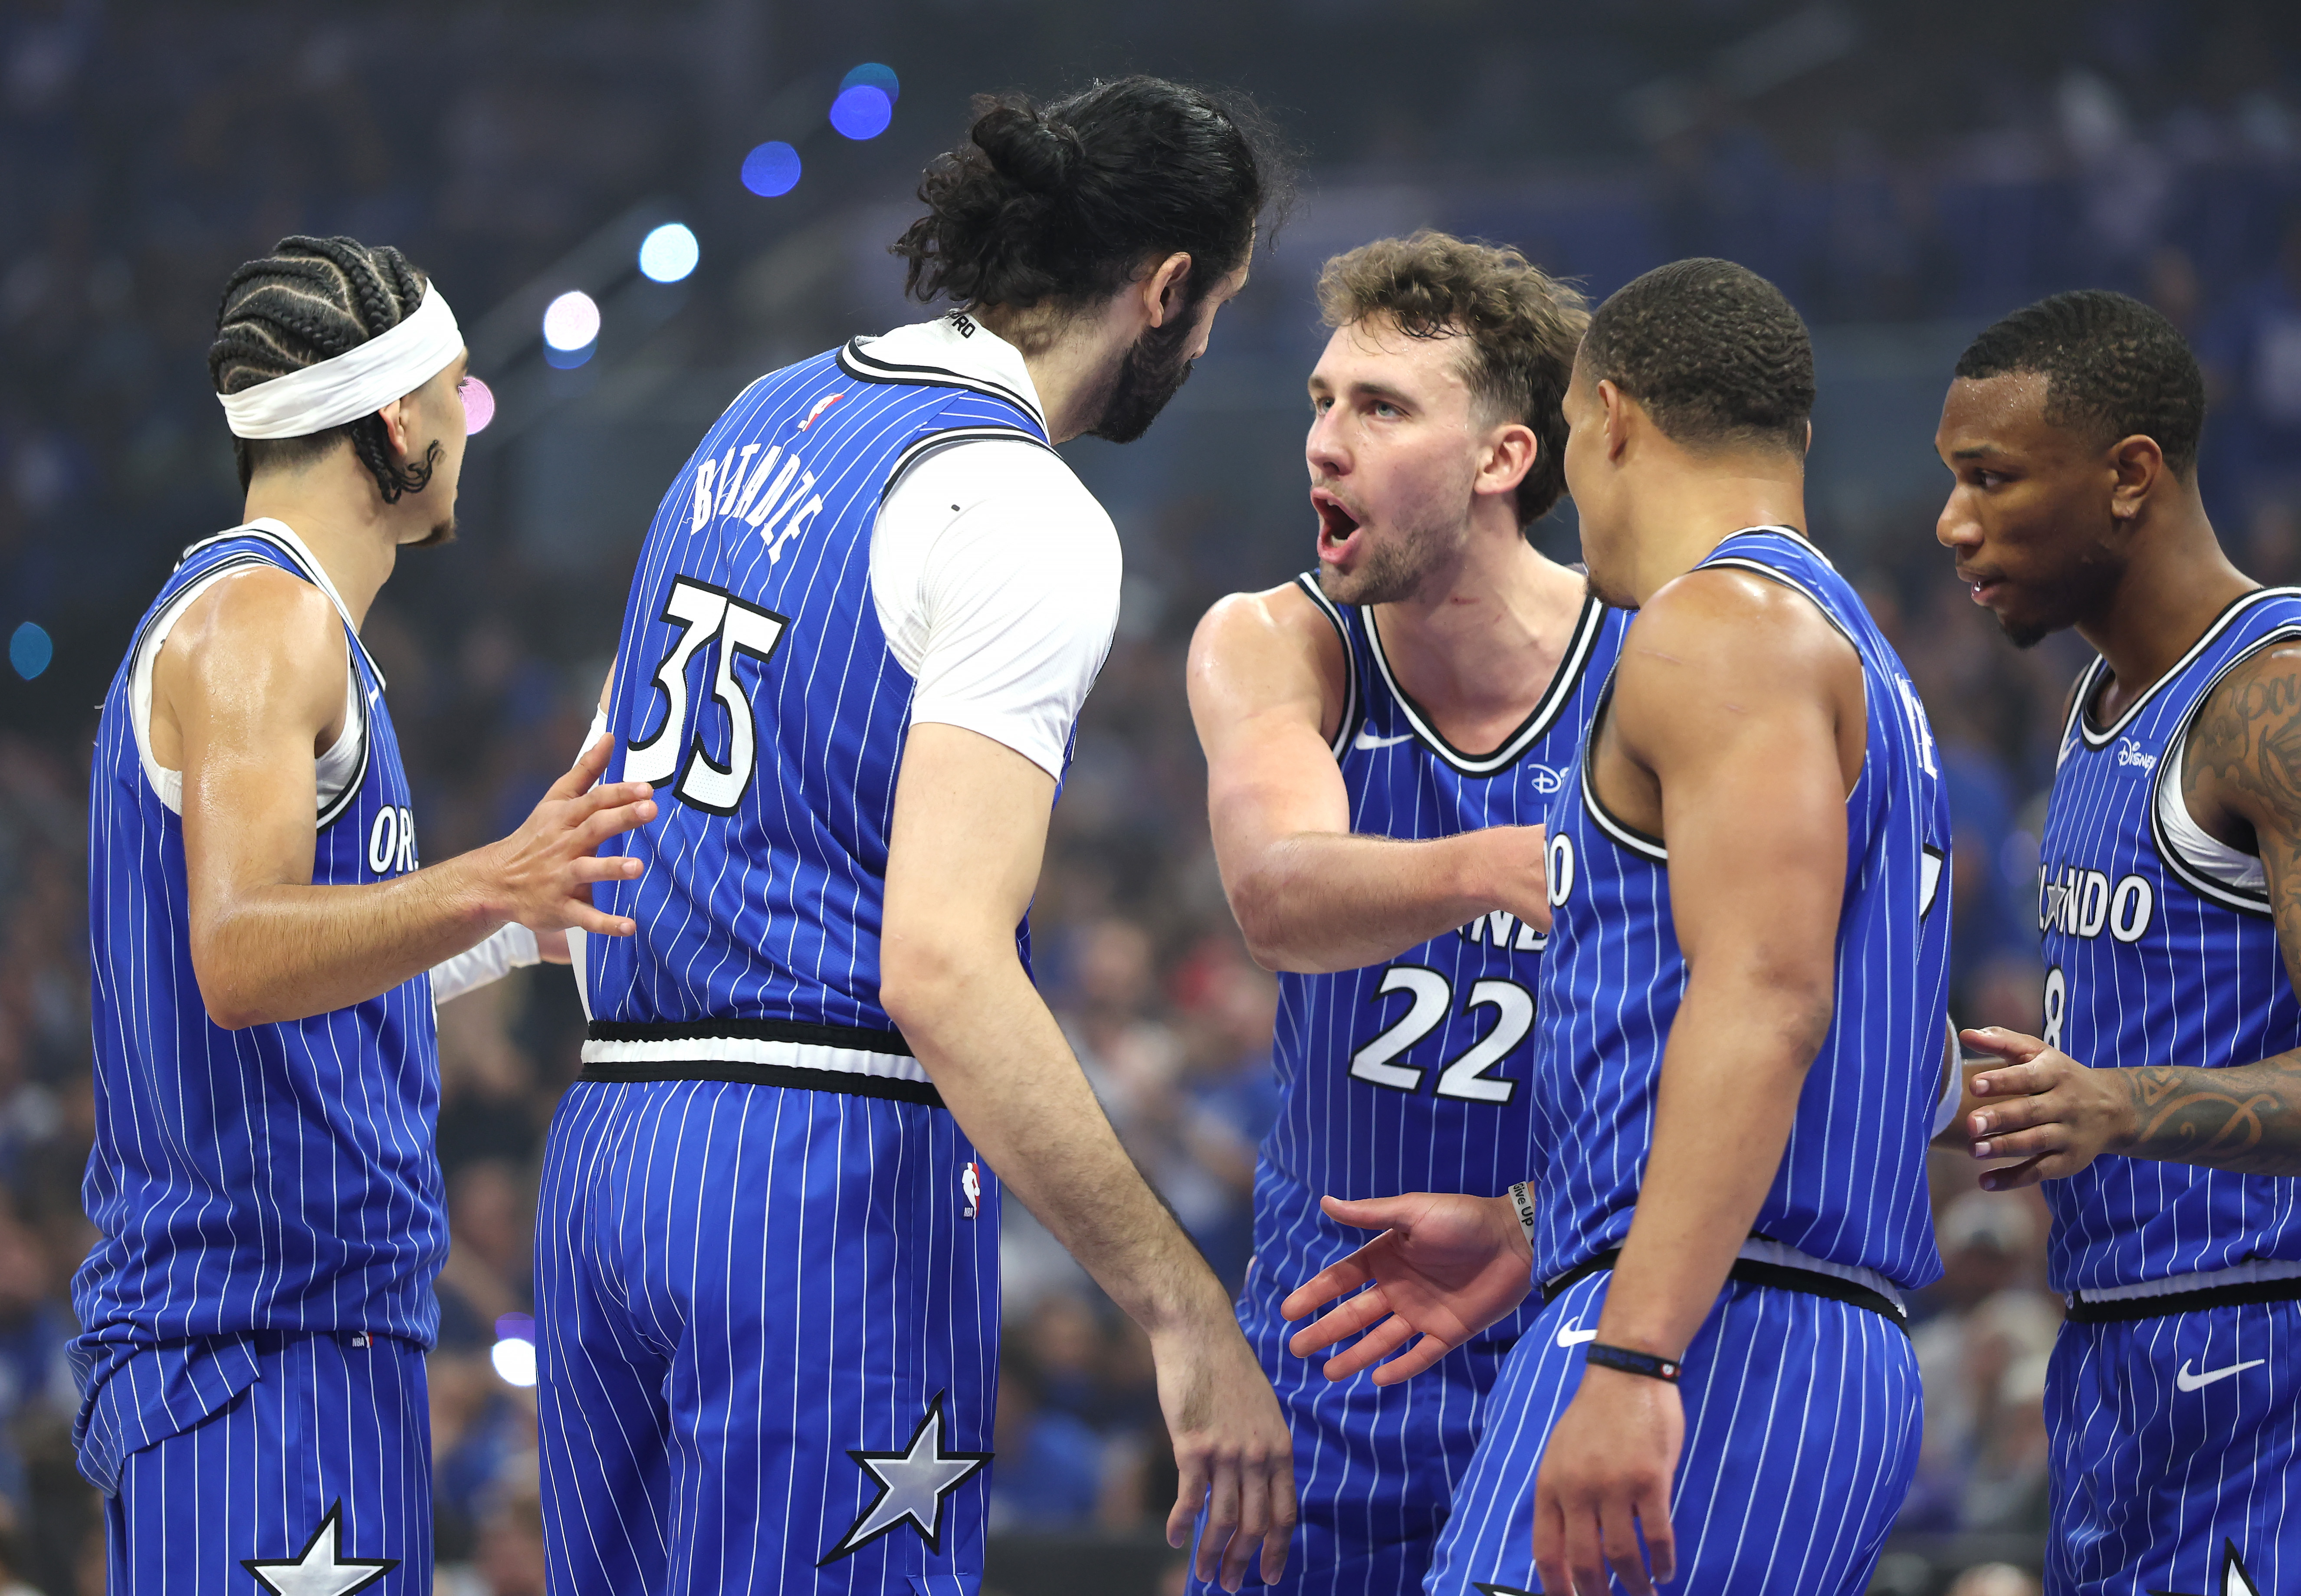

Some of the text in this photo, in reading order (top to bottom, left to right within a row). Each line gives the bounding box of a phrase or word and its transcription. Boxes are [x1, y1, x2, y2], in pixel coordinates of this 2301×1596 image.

[691, 443, 823, 565] BITADZE
[623, 573, 791, 817] 35
[1347, 963, 1537, 1107] 22
[964, 1207, 973, 1217] NBA
[1521, 1206, 1534, 1226] Up
[352, 1337, 364, 1347] NBA
